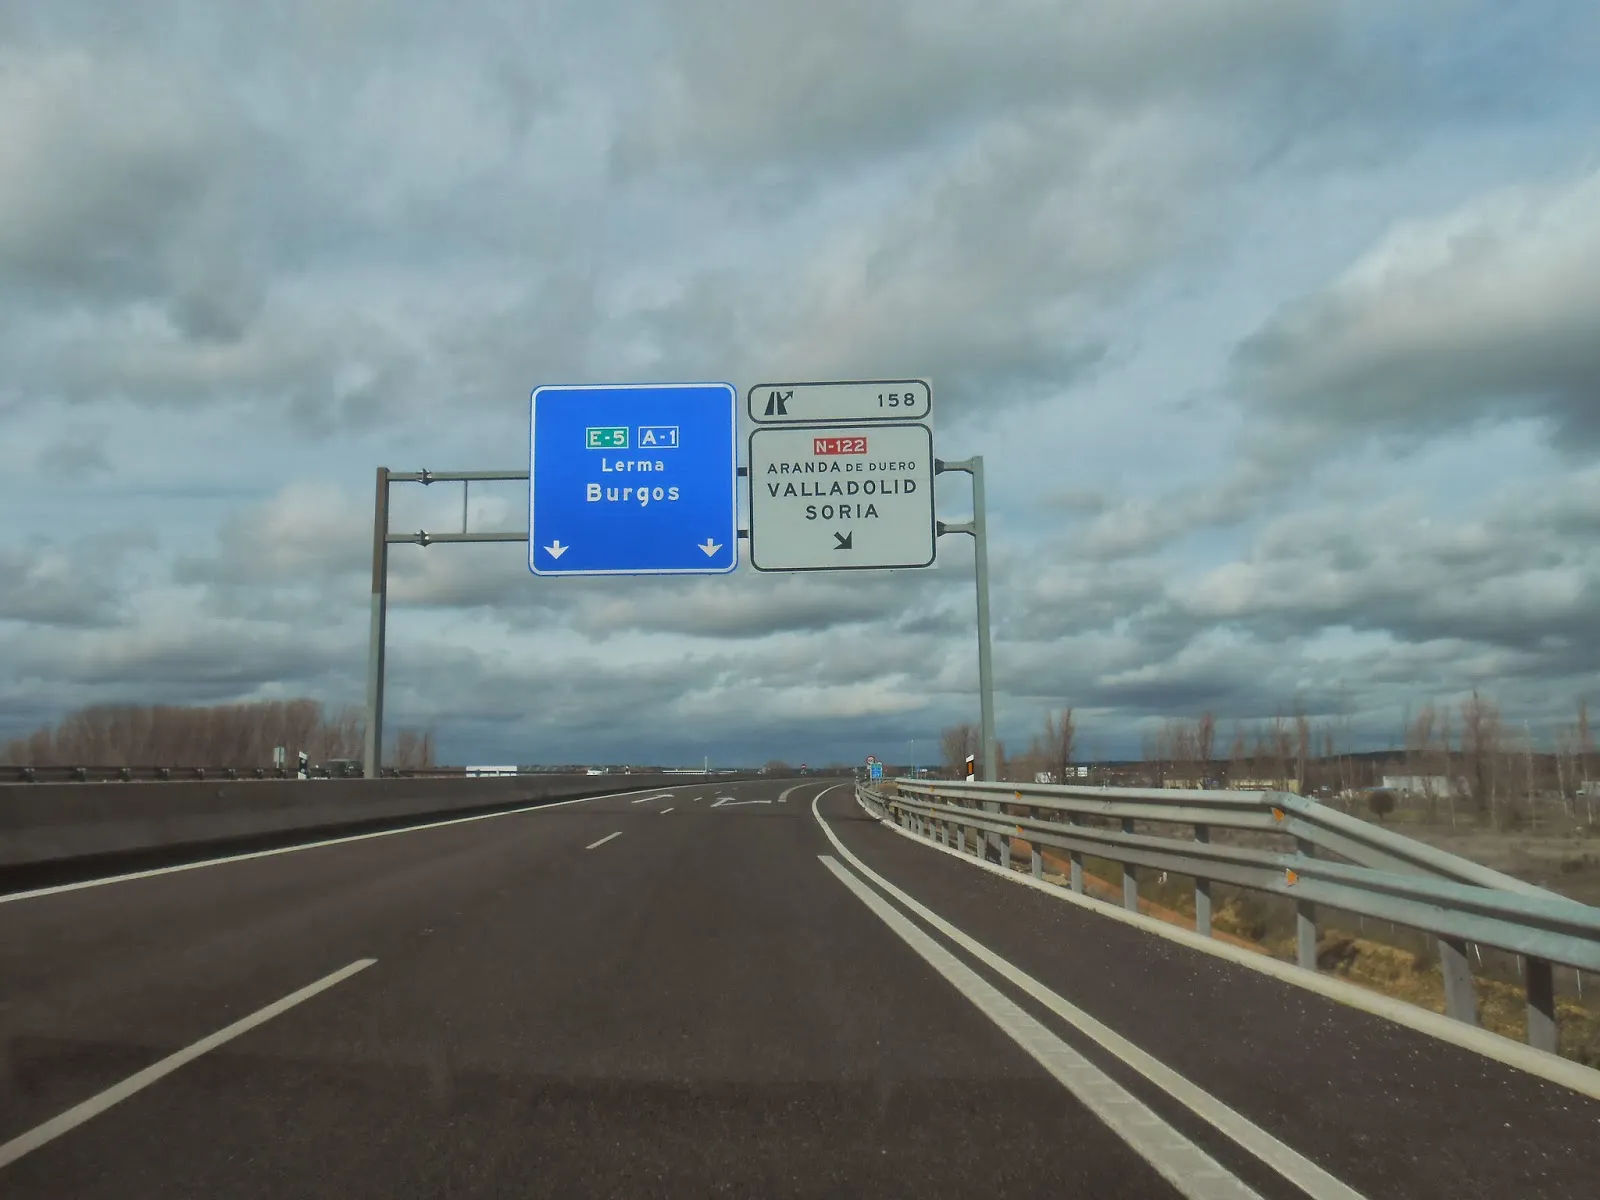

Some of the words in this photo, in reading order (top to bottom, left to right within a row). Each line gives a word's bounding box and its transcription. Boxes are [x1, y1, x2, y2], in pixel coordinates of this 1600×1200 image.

[878, 393, 915, 407] 158
[590, 430, 625, 446] E-5
[642, 430, 676, 445] A-1
[816, 440, 865, 453] N-122
[602, 458, 664, 472] Lerma
[767, 461, 841, 474] ARANDA
[846, 463, 863, 472] DE
[869, 461, 916, 471] DUERO
[587, 483, 680, 507] Burgos
[767, 479, 917, 497] VALLADOLID
[805, 504, 879, 520] SORIA
